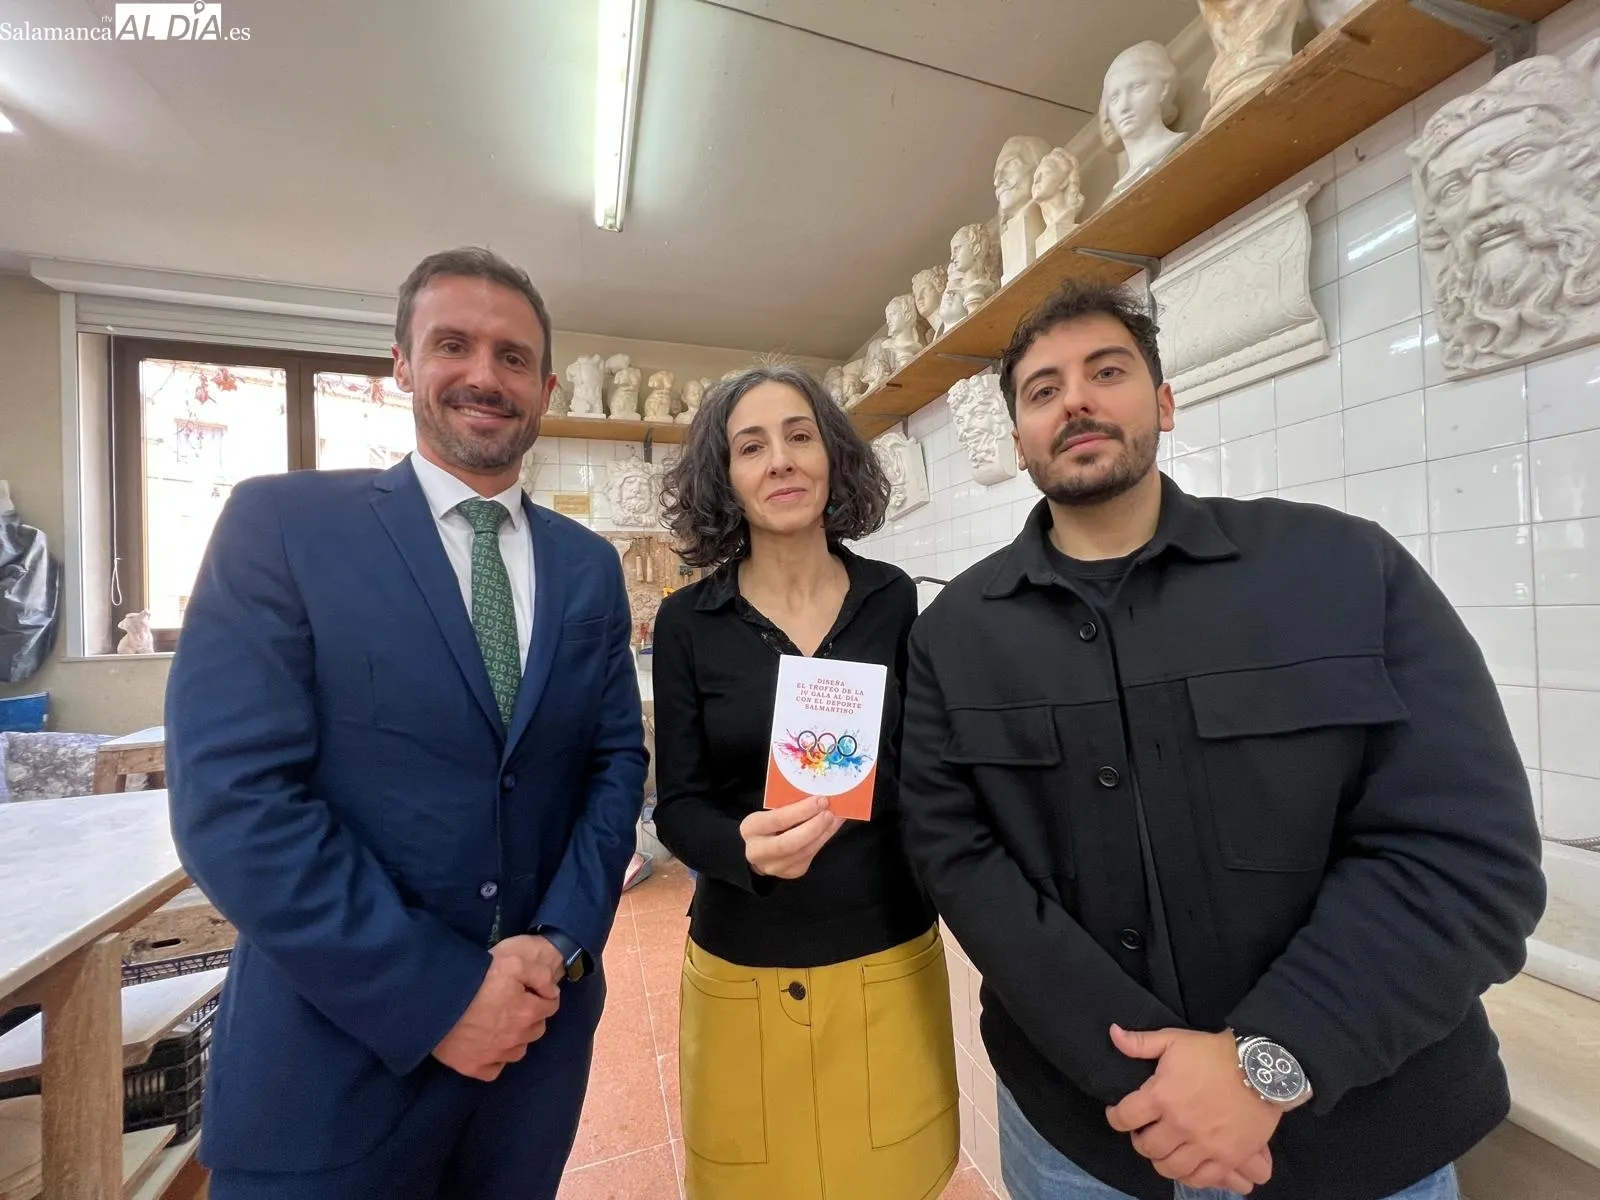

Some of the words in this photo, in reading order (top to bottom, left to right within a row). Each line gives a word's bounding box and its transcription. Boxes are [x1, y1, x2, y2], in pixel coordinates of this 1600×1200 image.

[817, 678, 845, 687] DISEÑA
[809, 684, 839, 693] TROFEO
[811, 691, 831, 699] GALA
[845, 694, 859, 702] DÍA
[826, 700, 862, 709] DEPORTE
[805, 704, 854, 715] SALMANTINO
